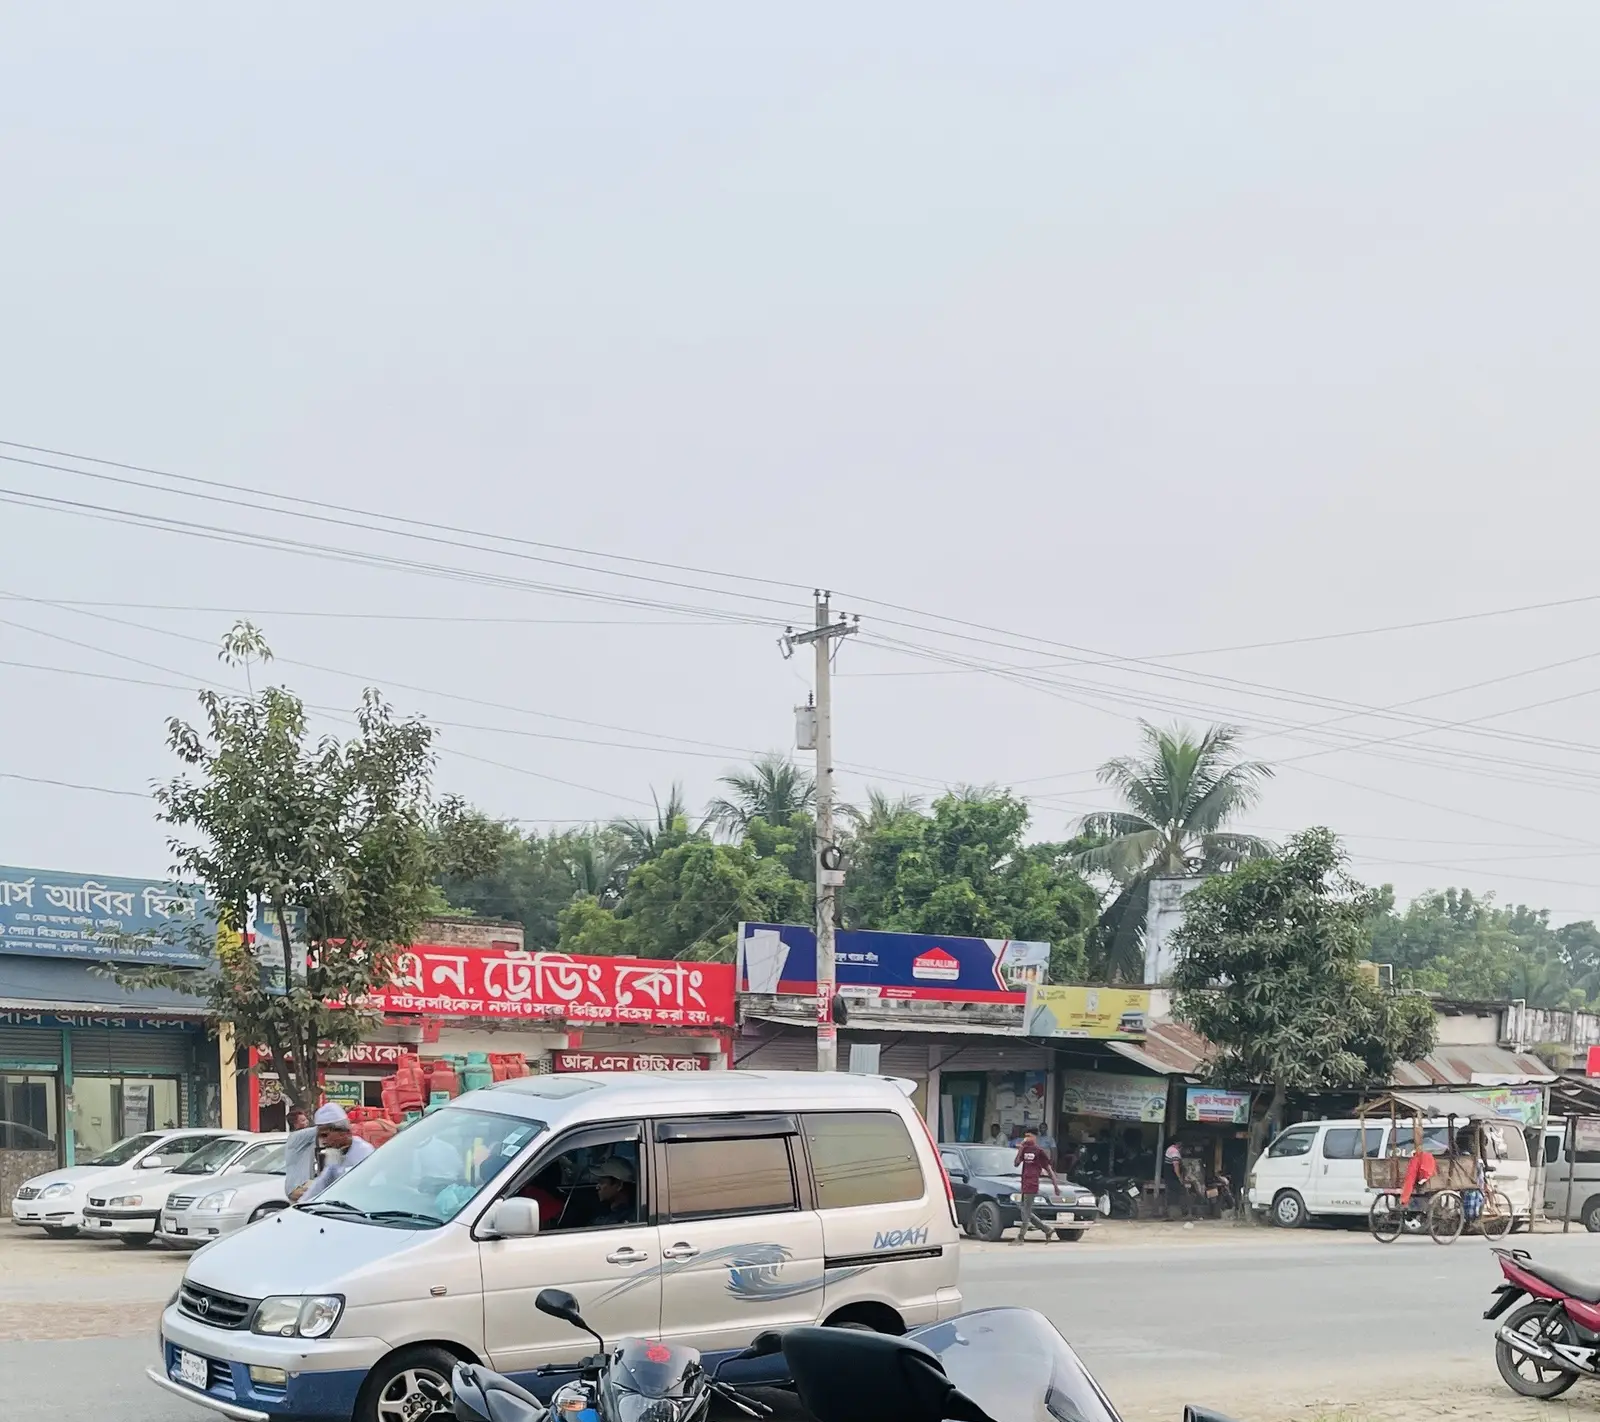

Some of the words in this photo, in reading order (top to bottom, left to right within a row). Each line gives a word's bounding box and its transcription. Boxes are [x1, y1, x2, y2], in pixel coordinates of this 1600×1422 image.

[0, 877, 35, 908] ার্স
[42, 881, 135, 917] আবির
[481, 949, 607, 1004] ট্রেডিং
[614, 962, 706, 1008] কোং
[488, 999, 522, 1015] নগদ
[615, 1002, 654, 1021] বিক্রয়
[656, 1007, 685, 1021] করা
[873, 1227, 929, 1250] NOAH
